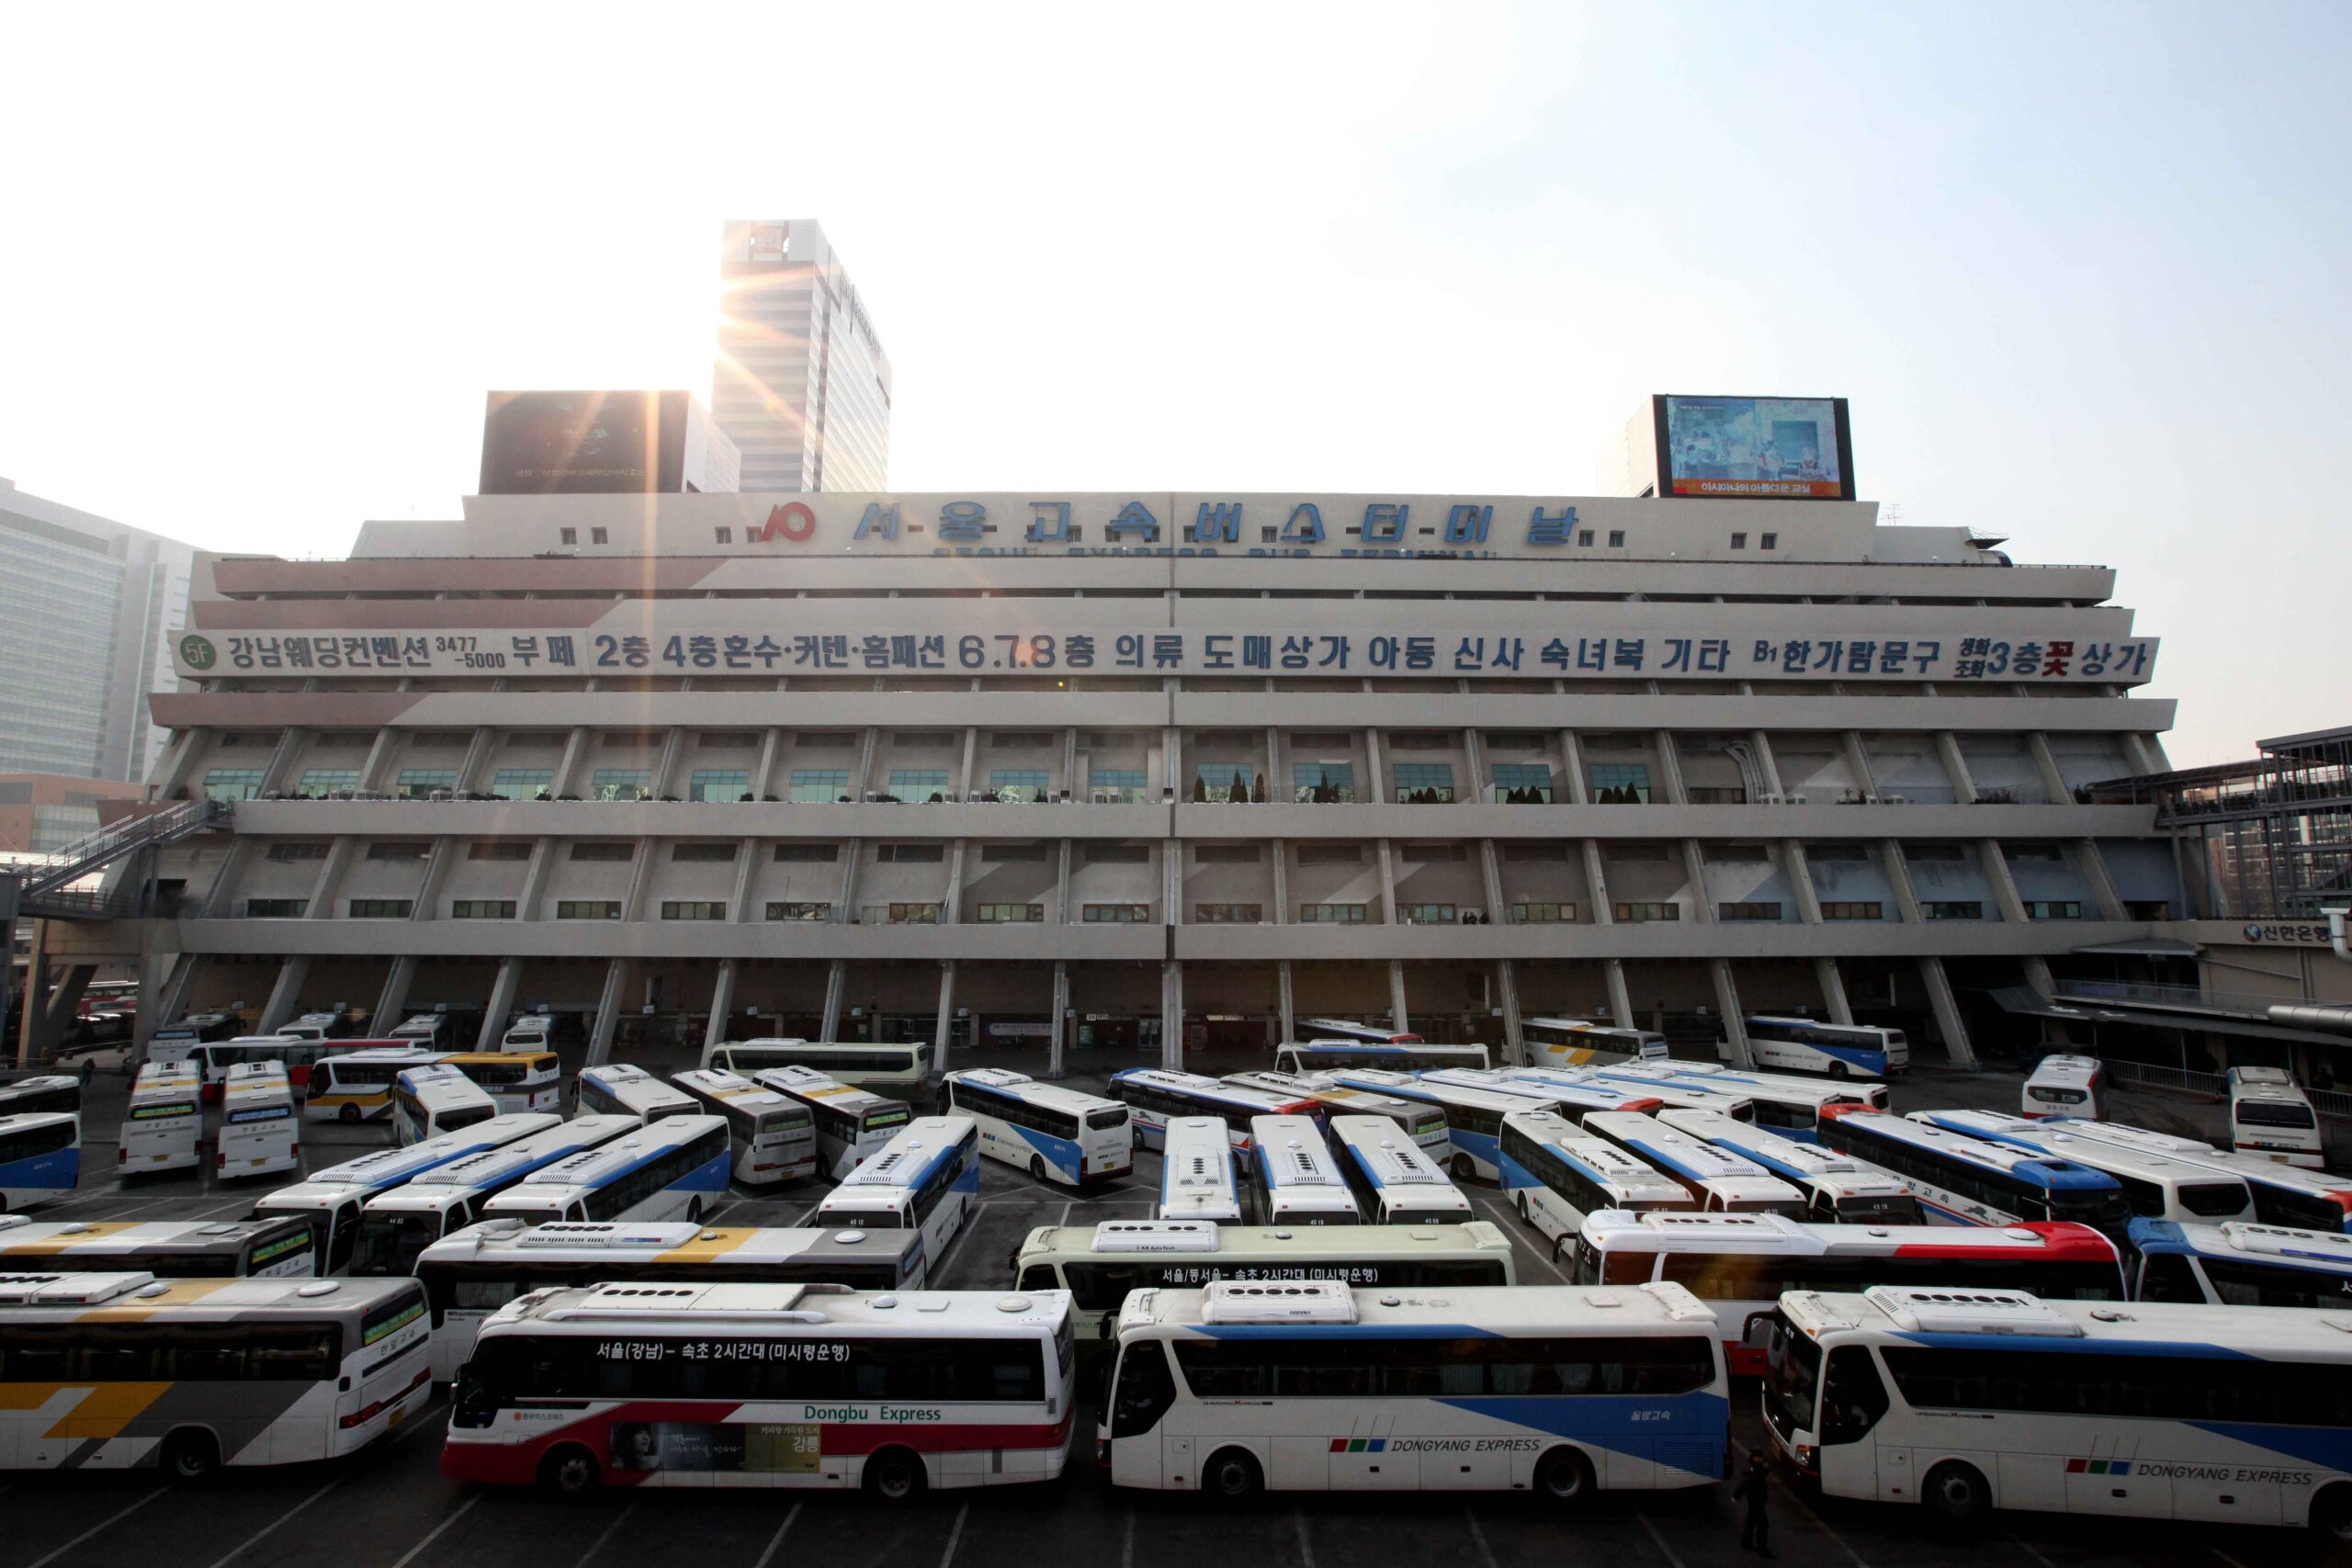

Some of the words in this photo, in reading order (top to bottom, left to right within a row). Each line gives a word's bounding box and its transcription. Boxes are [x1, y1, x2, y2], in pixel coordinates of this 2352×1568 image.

[1701, 482, 1749, 492] 아시아나의
[1751, 483, 1790, 493] 아름다운
[187, 643, 209, 664] 5F
[228, 637, 431, 668] 강남웨딩컨벤션
[435, 637, 477, 651] 3477
[512, 636, 576, 668] 부페
[595, 635, 650, 668] 2층
[958, 635, 1095, 668] 6.7.8층
[1115, 635, 1183, 668] 의류
[1204, 636, 1351, 669] 도매상가
[1369, 636, 1435, 670] 아동
[1454, 637, 1525, 671] 신사
[1541, 637, 1644, 671] 숙녀복
[1661, 639, 1730, 672] 기타
[1753, 640, 1777, 662] B1
[1782, 640, 1939, 673] 한가람문구
[1960, 637, 1992, 657] 생화
[1953, 660, 1986, 679] 조화
[2264, 925, 2330, 942] 신한은행
[1235, 1268, 1259, 1280] 속초
[1310, 1268, 1378, 1283] (미시령운행)
[682, 1342, 710, 1360] 속초
[714, 1342, 765, 1360] 2시간대
[768, 1342, 851, 1362] (미시령운행)
[804, 1405, 868, 1424] Dongbu
[879, 1405, 942, 1424] Express
[793, 1436, 820, 1453] 강릉
[1391, 1439, 1470, 1452] DONGYANG
[1475, 1438, 1541, 1451] EXPRESS
[2137, 1463, 2230, 1482] DONGYANG
[2234, 1470, 2313, 1485] EXPRESS
